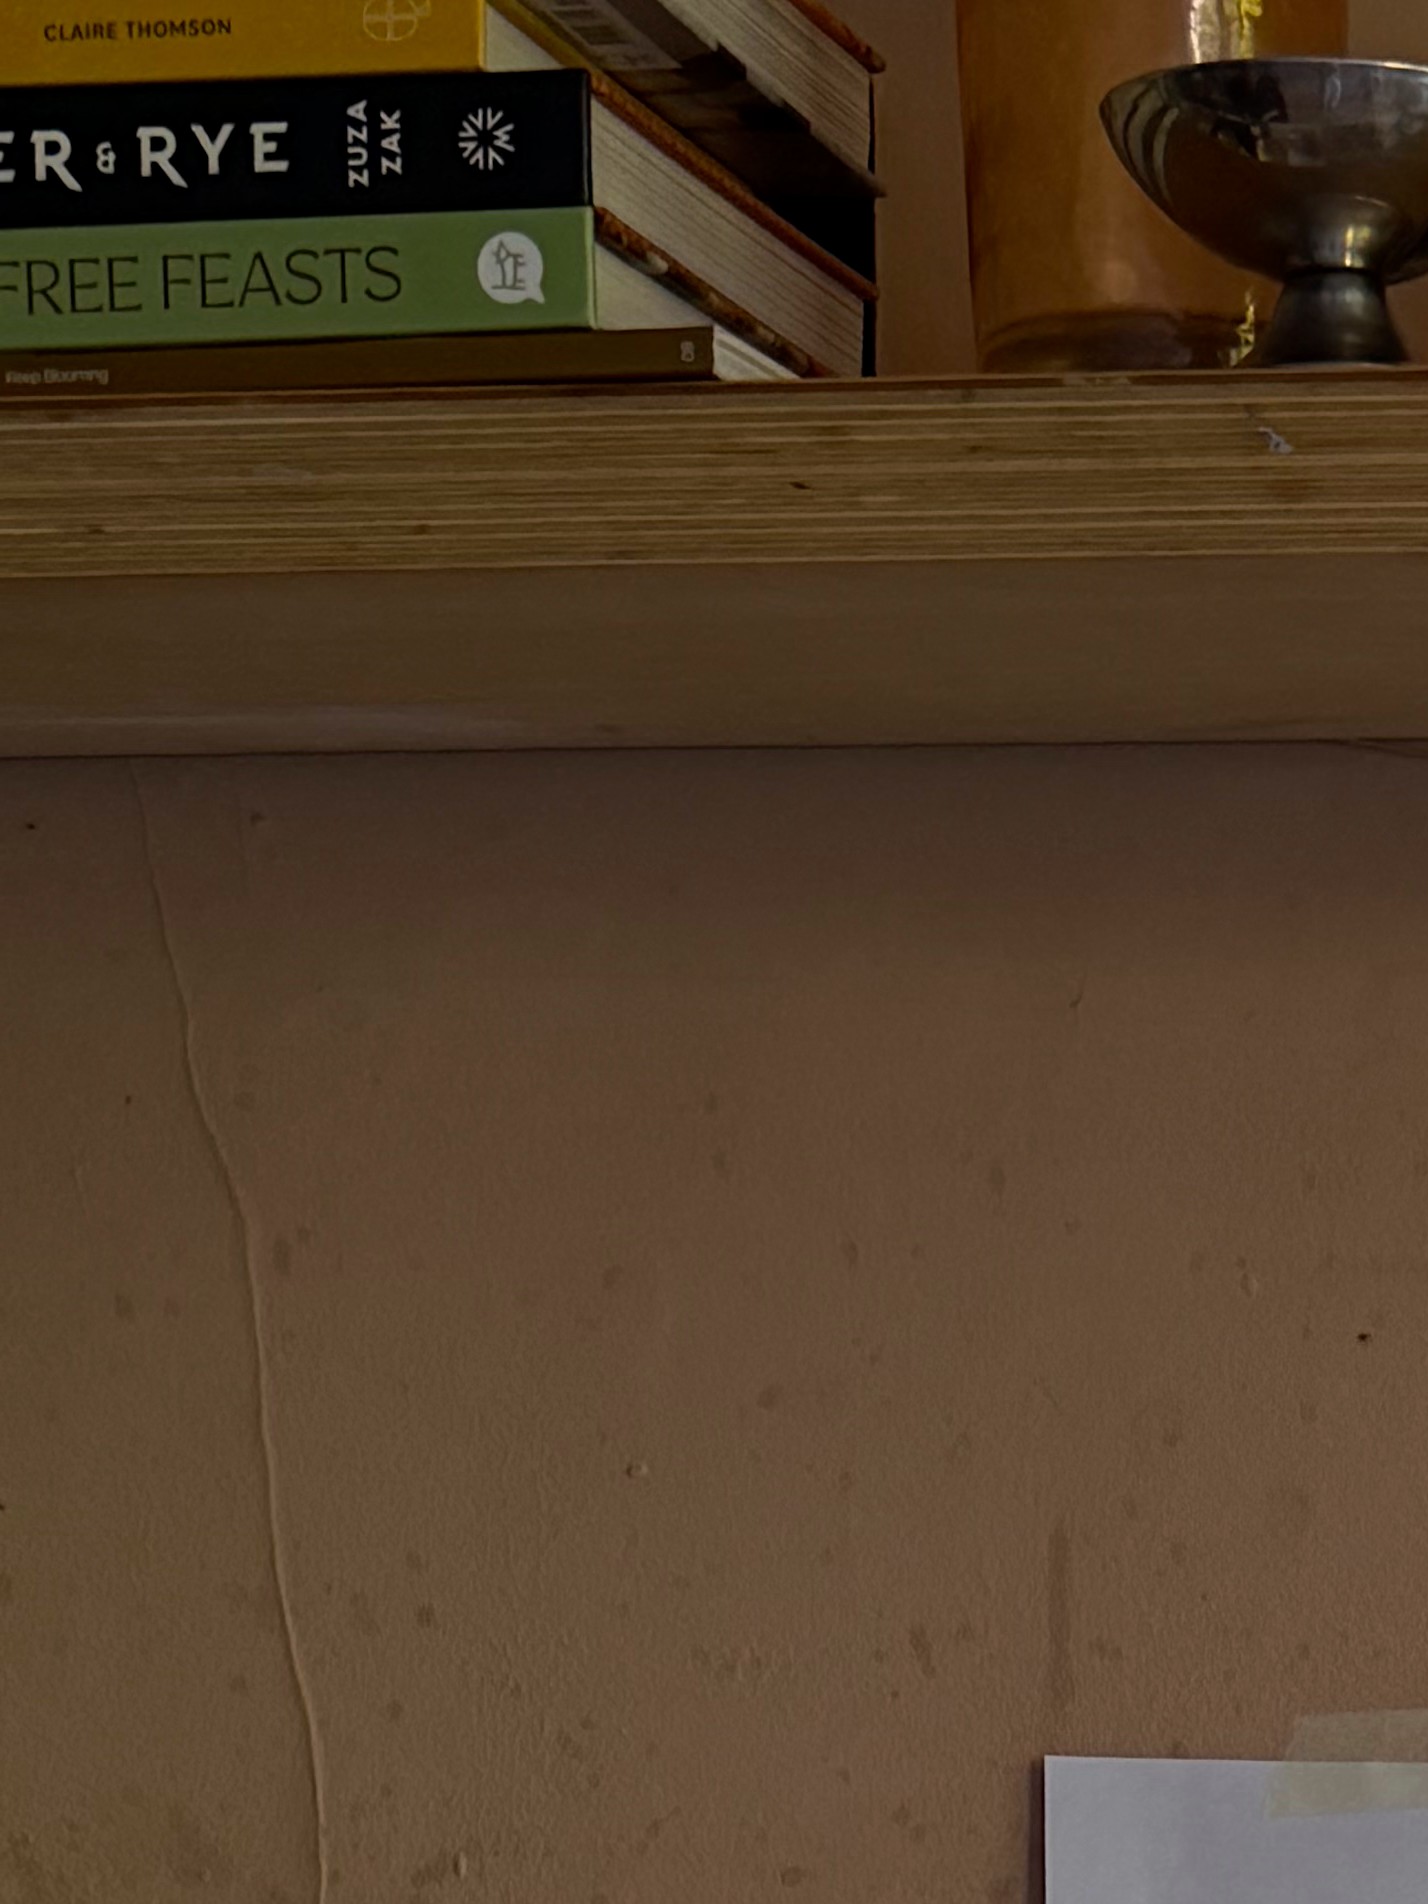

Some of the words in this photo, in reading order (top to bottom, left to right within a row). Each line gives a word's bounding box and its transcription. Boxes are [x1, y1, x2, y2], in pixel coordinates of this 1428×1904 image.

[43, 22, 118, 42] CLAIRE
[126, 18, 232, 39] THOMSON
[96, 141, 116, 174] &
[136, 121, 290, 188] RYE
[346, 98, 369, 188] ZUZA
[380, 109, 402, 175] ZAK
[162, 246, 402, 311] FEASTS
